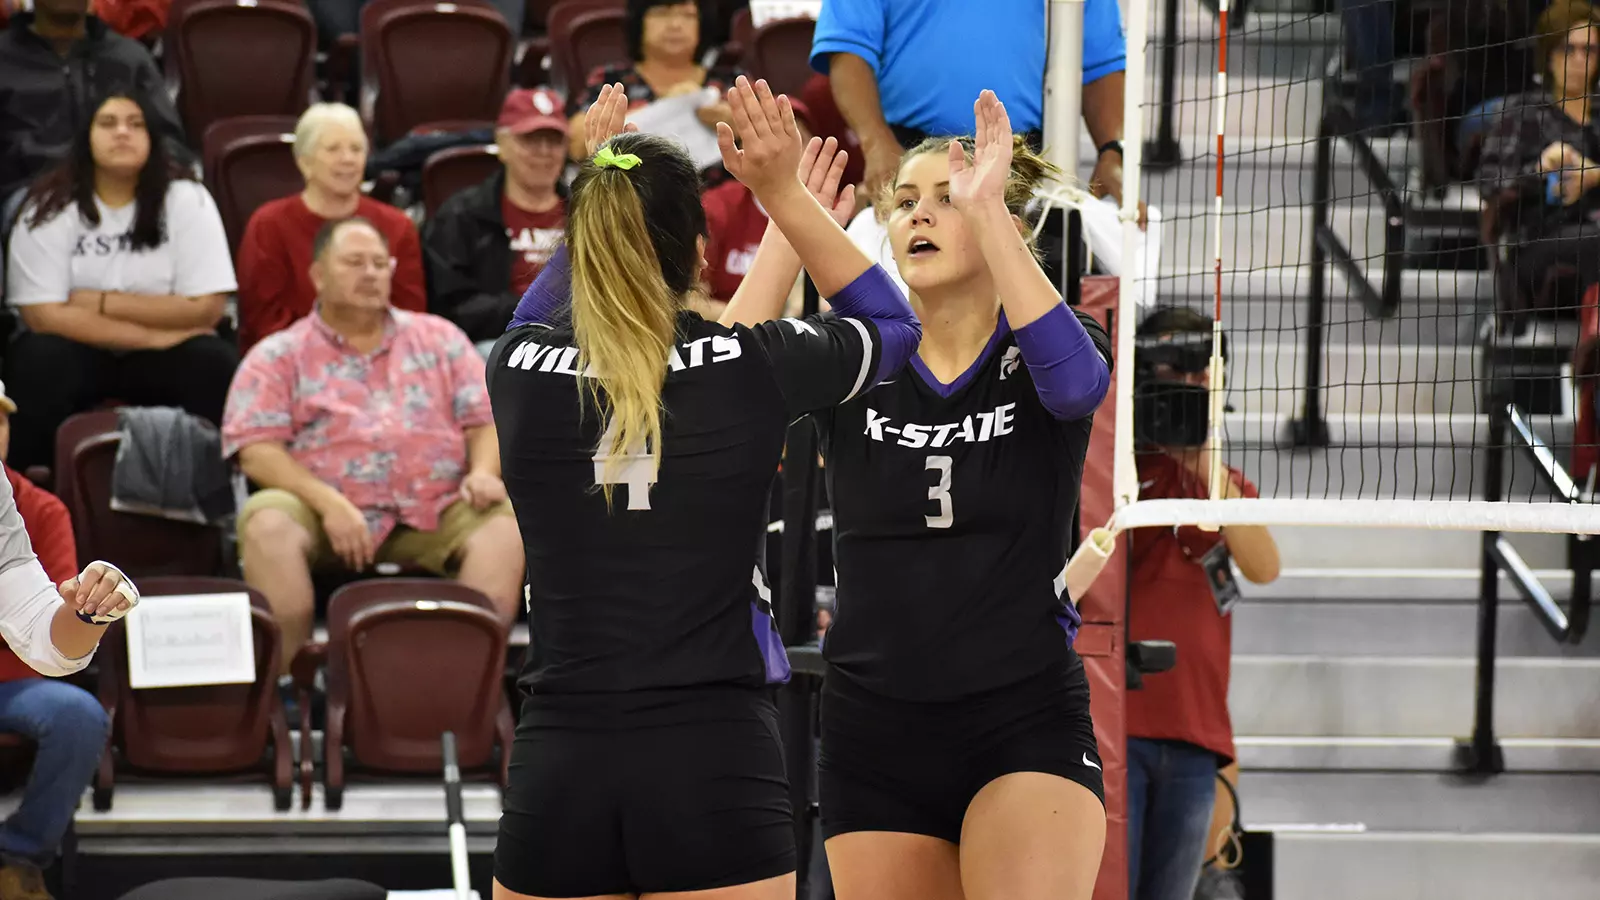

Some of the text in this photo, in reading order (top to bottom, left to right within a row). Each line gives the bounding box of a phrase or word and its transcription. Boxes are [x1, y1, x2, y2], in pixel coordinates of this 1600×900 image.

[592, 410, 659, 511] 4
[863, 402, 1016, 448] K-STATE
[924, 455, 954, 529] 3
